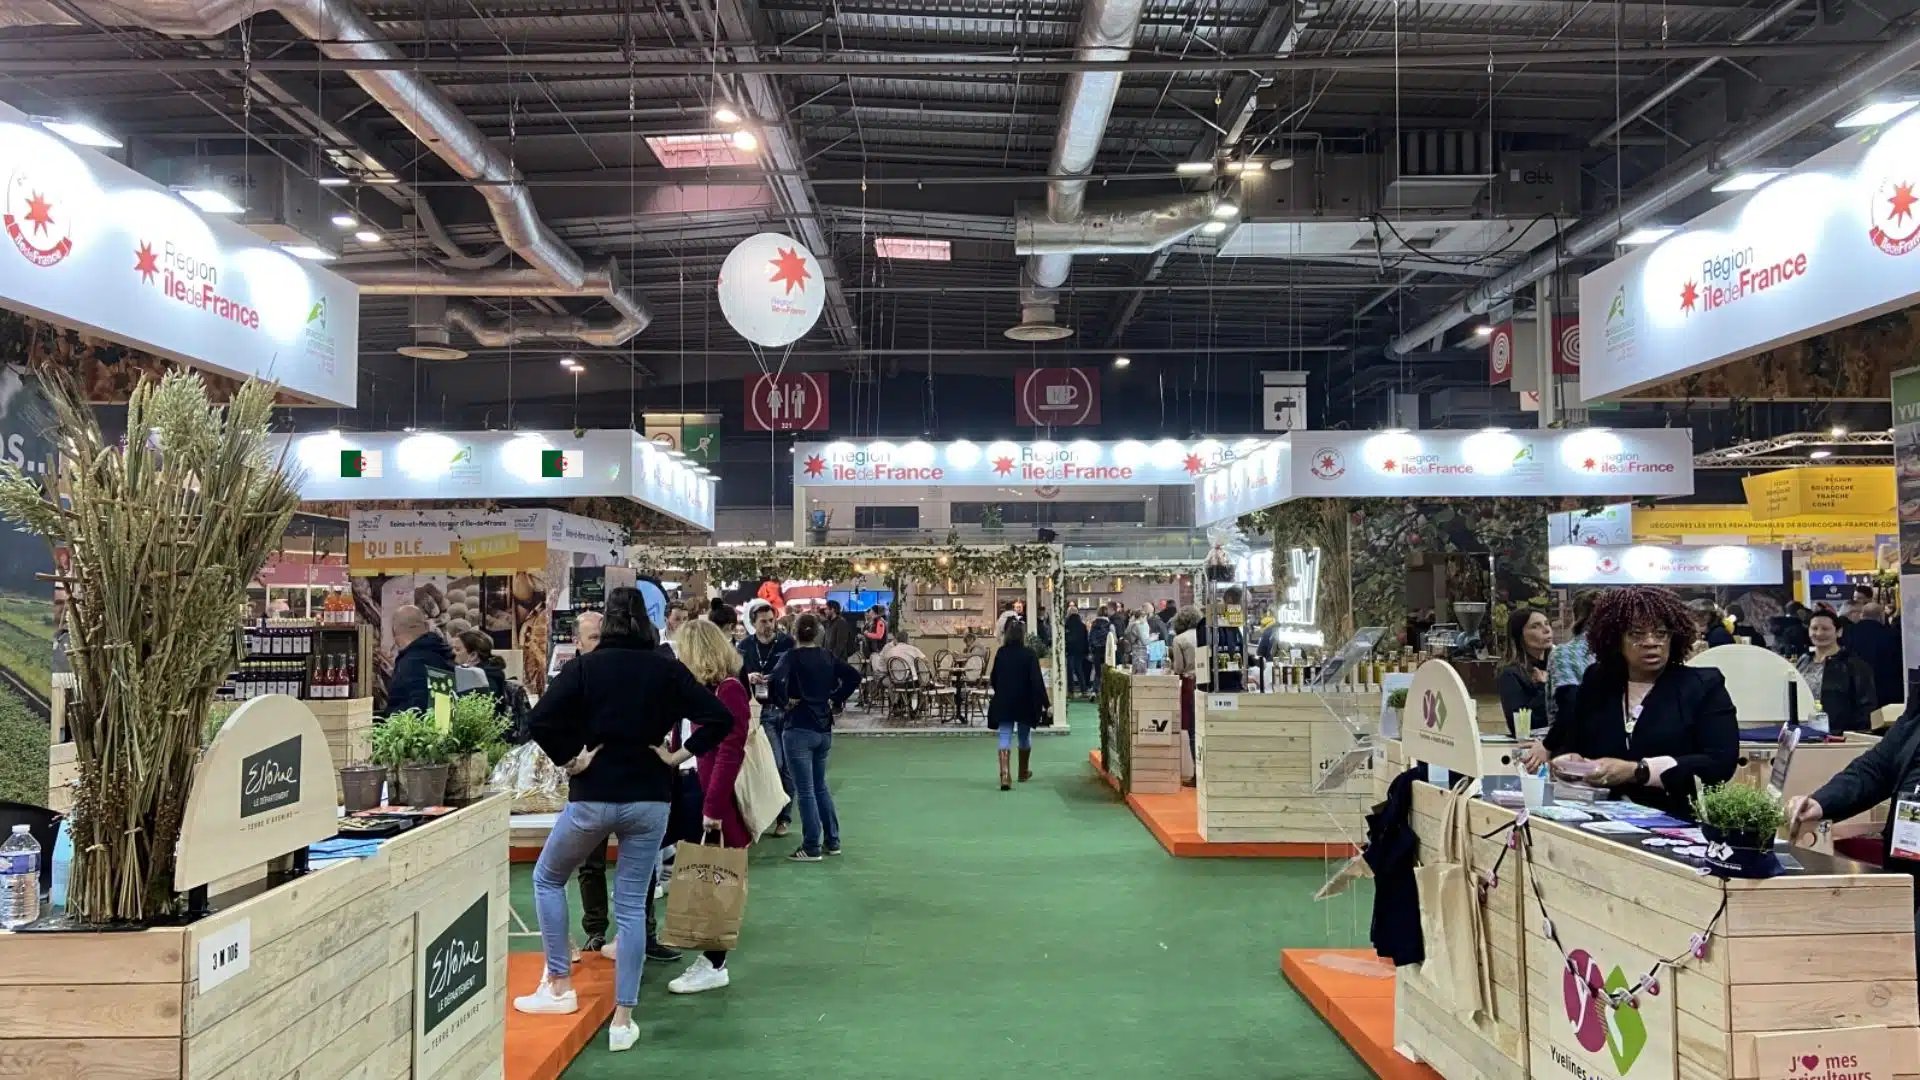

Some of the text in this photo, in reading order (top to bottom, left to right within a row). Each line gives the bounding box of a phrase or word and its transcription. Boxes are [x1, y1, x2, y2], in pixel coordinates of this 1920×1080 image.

[1702, 245, 1753, 283] Région
[212, 953, 218, 970] 3
[1550, 1044, 1587, 1080] Yvelines
[1825, 1055, 1858, 1069] mes
